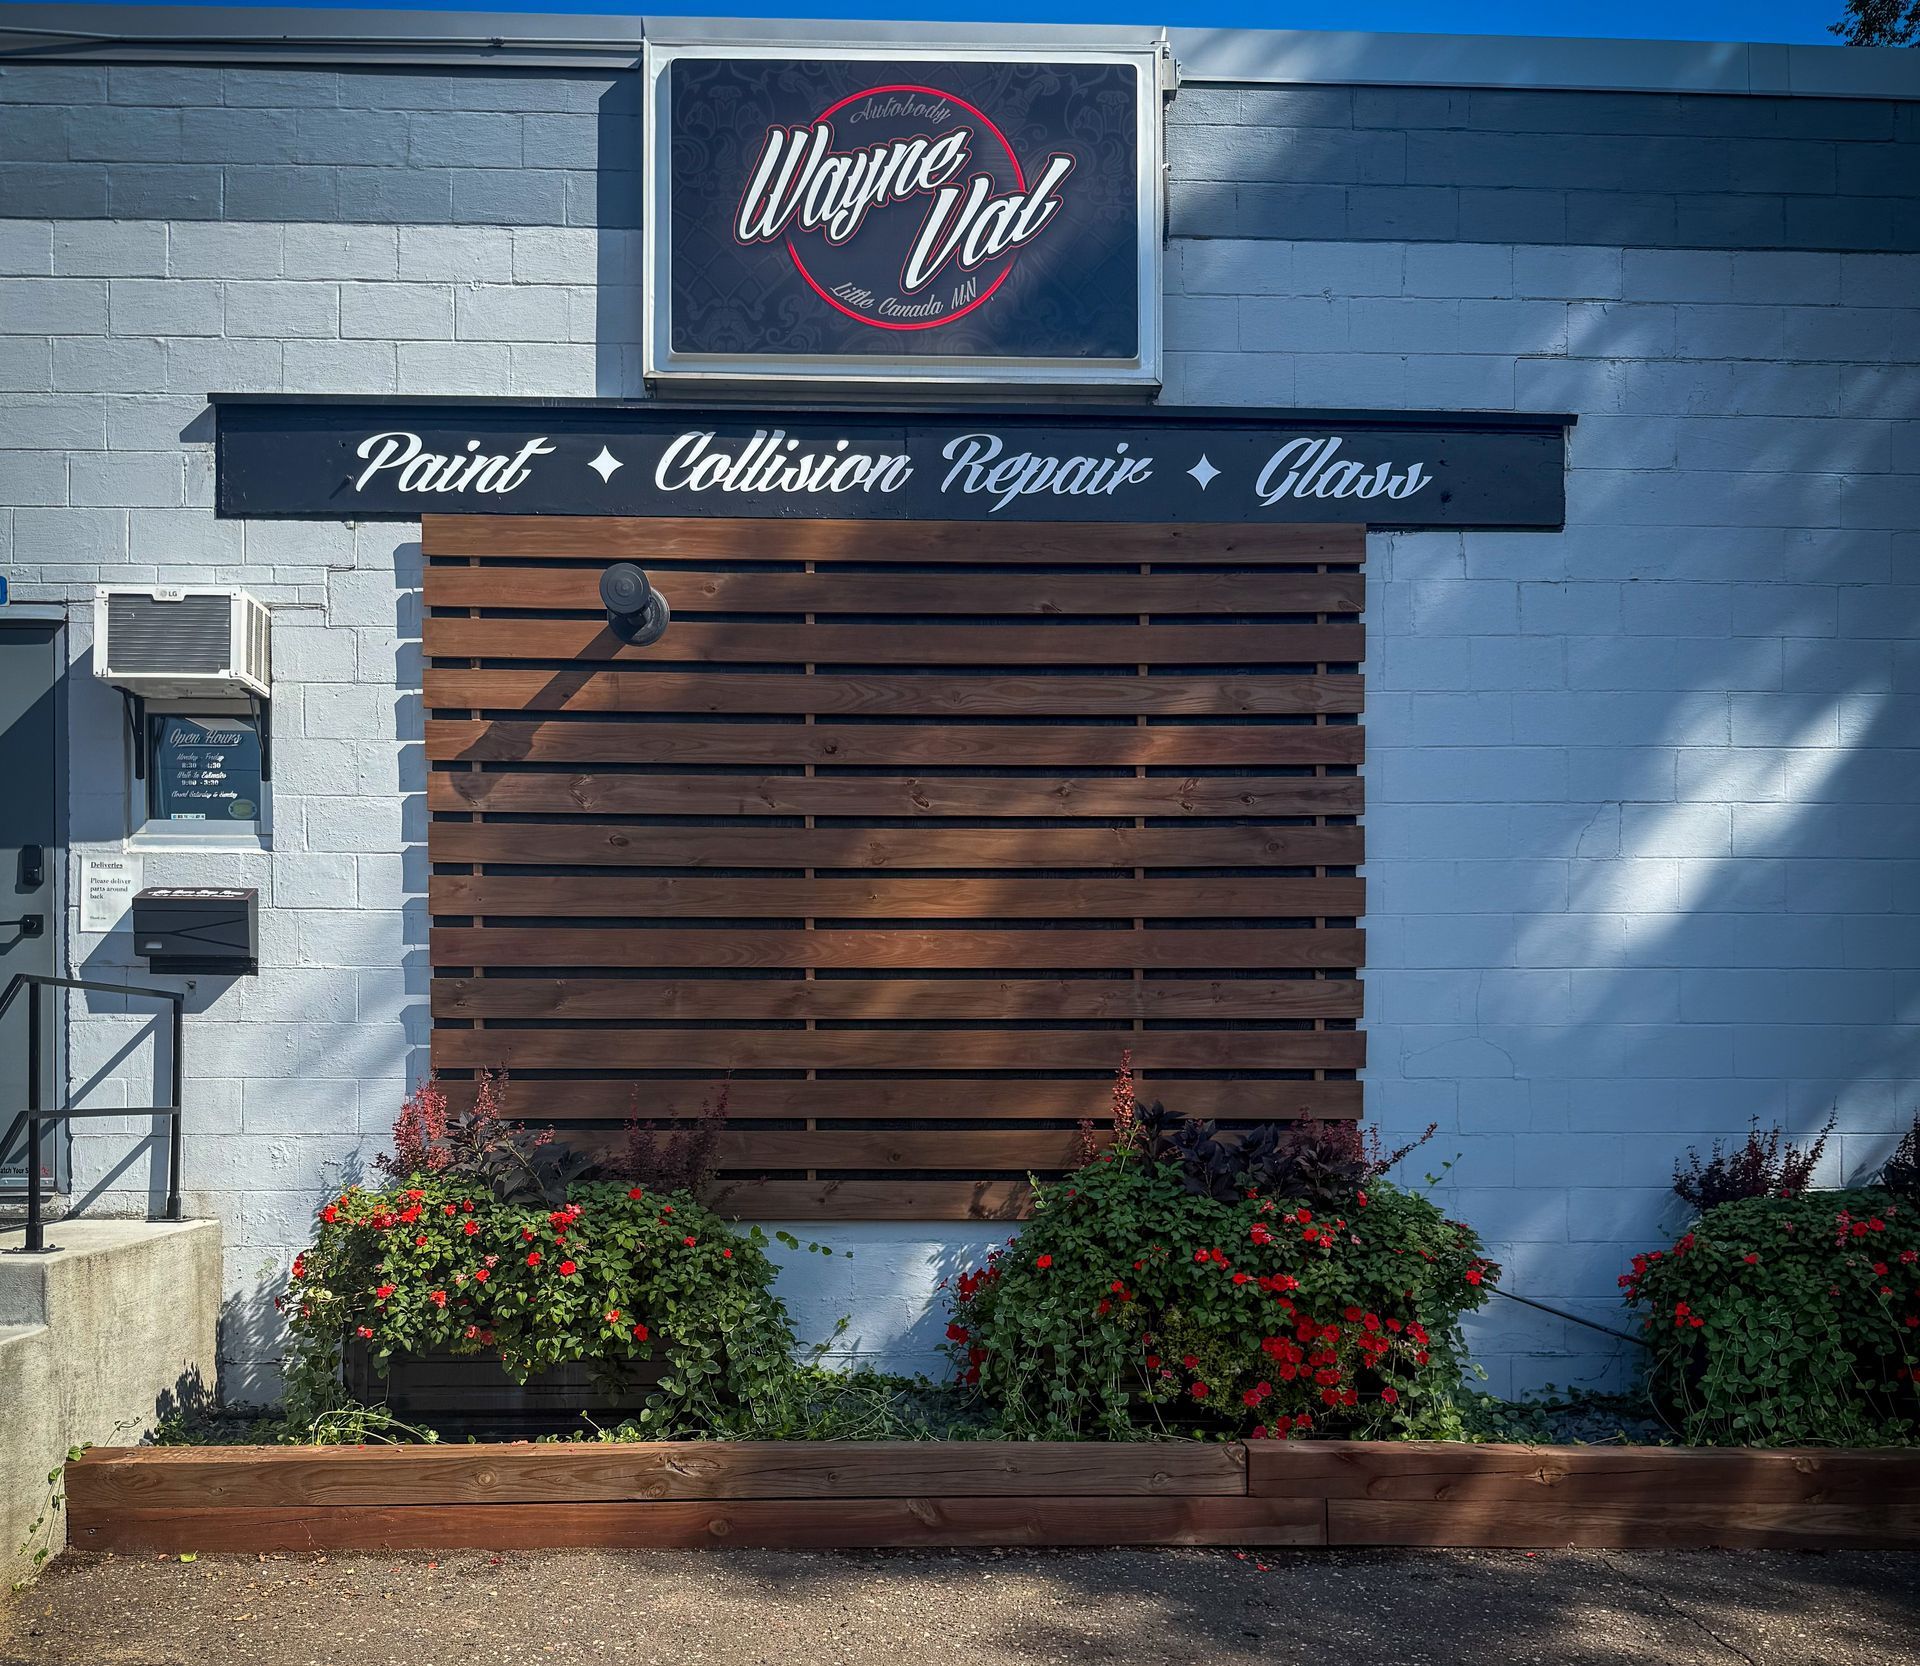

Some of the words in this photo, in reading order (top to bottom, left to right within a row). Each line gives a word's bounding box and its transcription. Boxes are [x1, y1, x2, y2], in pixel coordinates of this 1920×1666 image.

[850, 94, 951, 124] Autobody
[739, 125, 969, 240] Wayne
[906, 158, 1072, 290] Val
[829, 281, 875, 310] Little
[878, 294, 944, 318] Canada
[951, 277, 977, 311] MN
[356, 431, 557, 494] Paint
[655, 430, 914, 495] Collision
[941, 433, 1153, 513] Repair
[1255, 436, 1433, 508] Glass
[170, 728, 200, 748] Open
[205, 730, 242, 744] Hours
[90, 861, 123, 869] Deliveries
[90, 877, 109, 885] Please
[110, 877, 131, 885] deliver
[90, 885, 106, 893] parts
[90, 892, 104, 900] back
